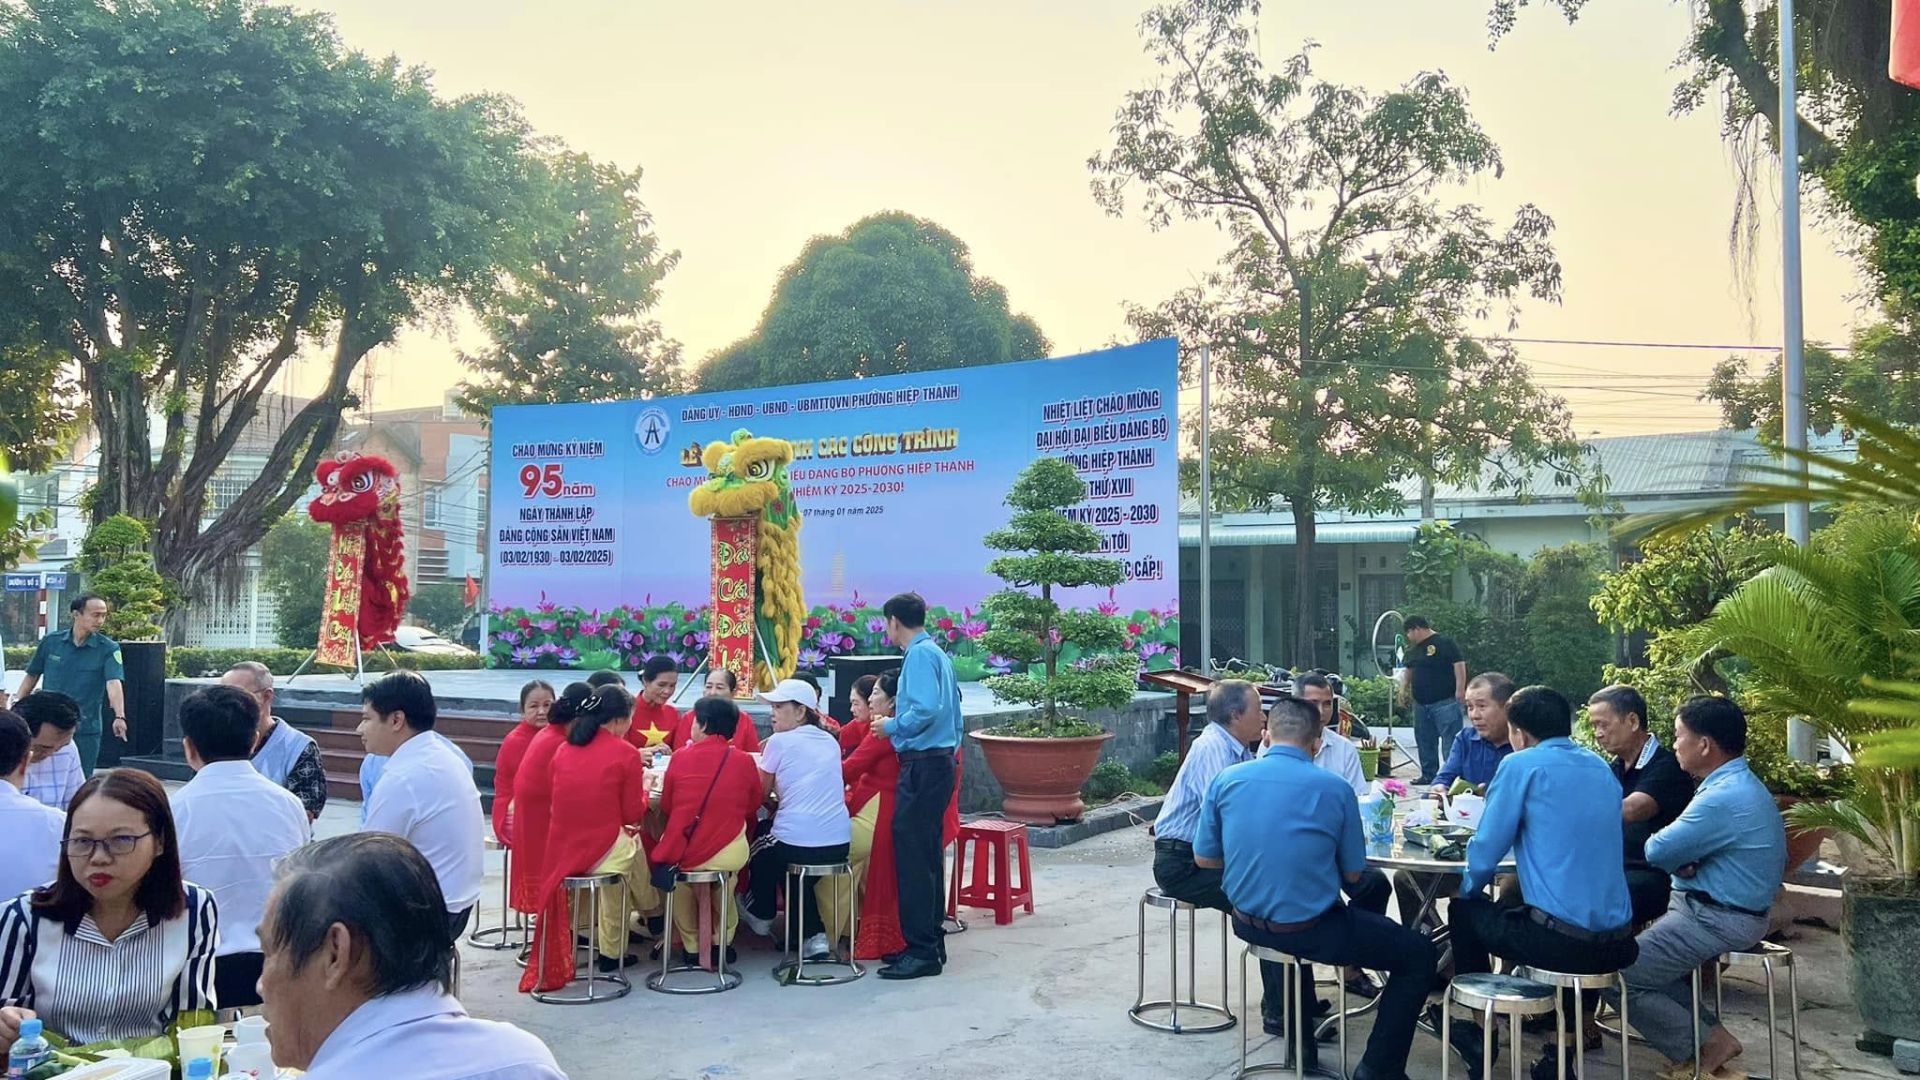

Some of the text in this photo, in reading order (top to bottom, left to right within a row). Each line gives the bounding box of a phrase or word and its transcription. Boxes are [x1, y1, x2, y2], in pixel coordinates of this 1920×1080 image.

[762, 401, 788, 414] UBND
[1043, 389, 1159, 421] NHIỆT LIỆT CHÀO MỪNG
[1037, 415, 1166, 449] ĐẠI HỘI ĐẠI BIỂU ĐẢNG BỘ
[1091, 450, 1114, 471] HIỆP
[1117, 446, 1152, 466] THÀNH
[520, 464, 593, 496] 95 năm
[840, 481, 904, 495] 2025-2030!
[1089, 476, 1109, 496] THỨ
[1111, 478, 1131, 494] XVII
[520, 504, 593, 522] NGÀY THÀNH LẬP
[865, 505, 884, 514] 2025
[1095, 507, 1120, 522] 2025
[1130, 504, 1156, 520] 2030
[499, 525, 613, 544] ĐẢNG CỘNG SẢN VIỆT NAM
[1112, 530, 1128, 549] TỚI
[500, 551, 550, 564] (03/02/1930
[560, 550, 612, 563] 03/02/2025)
[1135, 555, 1160, 577] CẤP!
